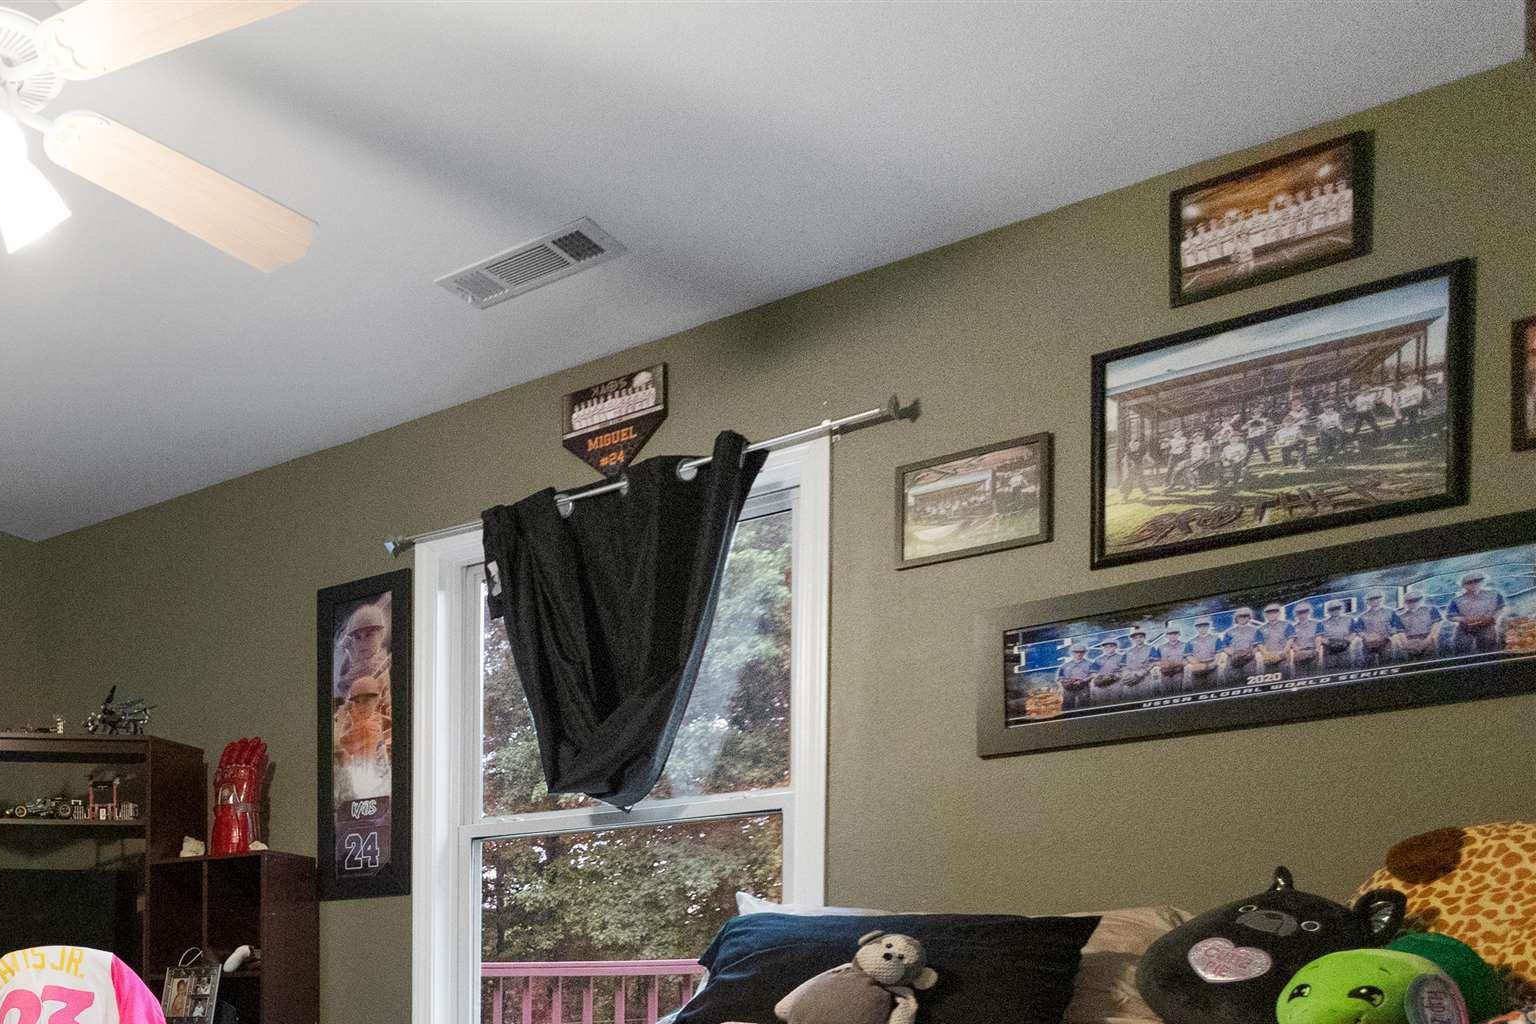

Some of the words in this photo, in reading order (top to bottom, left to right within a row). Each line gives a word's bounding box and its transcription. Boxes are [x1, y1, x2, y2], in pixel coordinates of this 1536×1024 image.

[587, 426, 637, 451] MIGUEL
[1198, 686, 1263, 700] GLOBAL
[1270, 676, 1331, 691] WORLD
[1338, 667, 1400, 681] SERIES
[1246, 672, 1282, 685] 2020
[345, 832, 379, 870] 24
